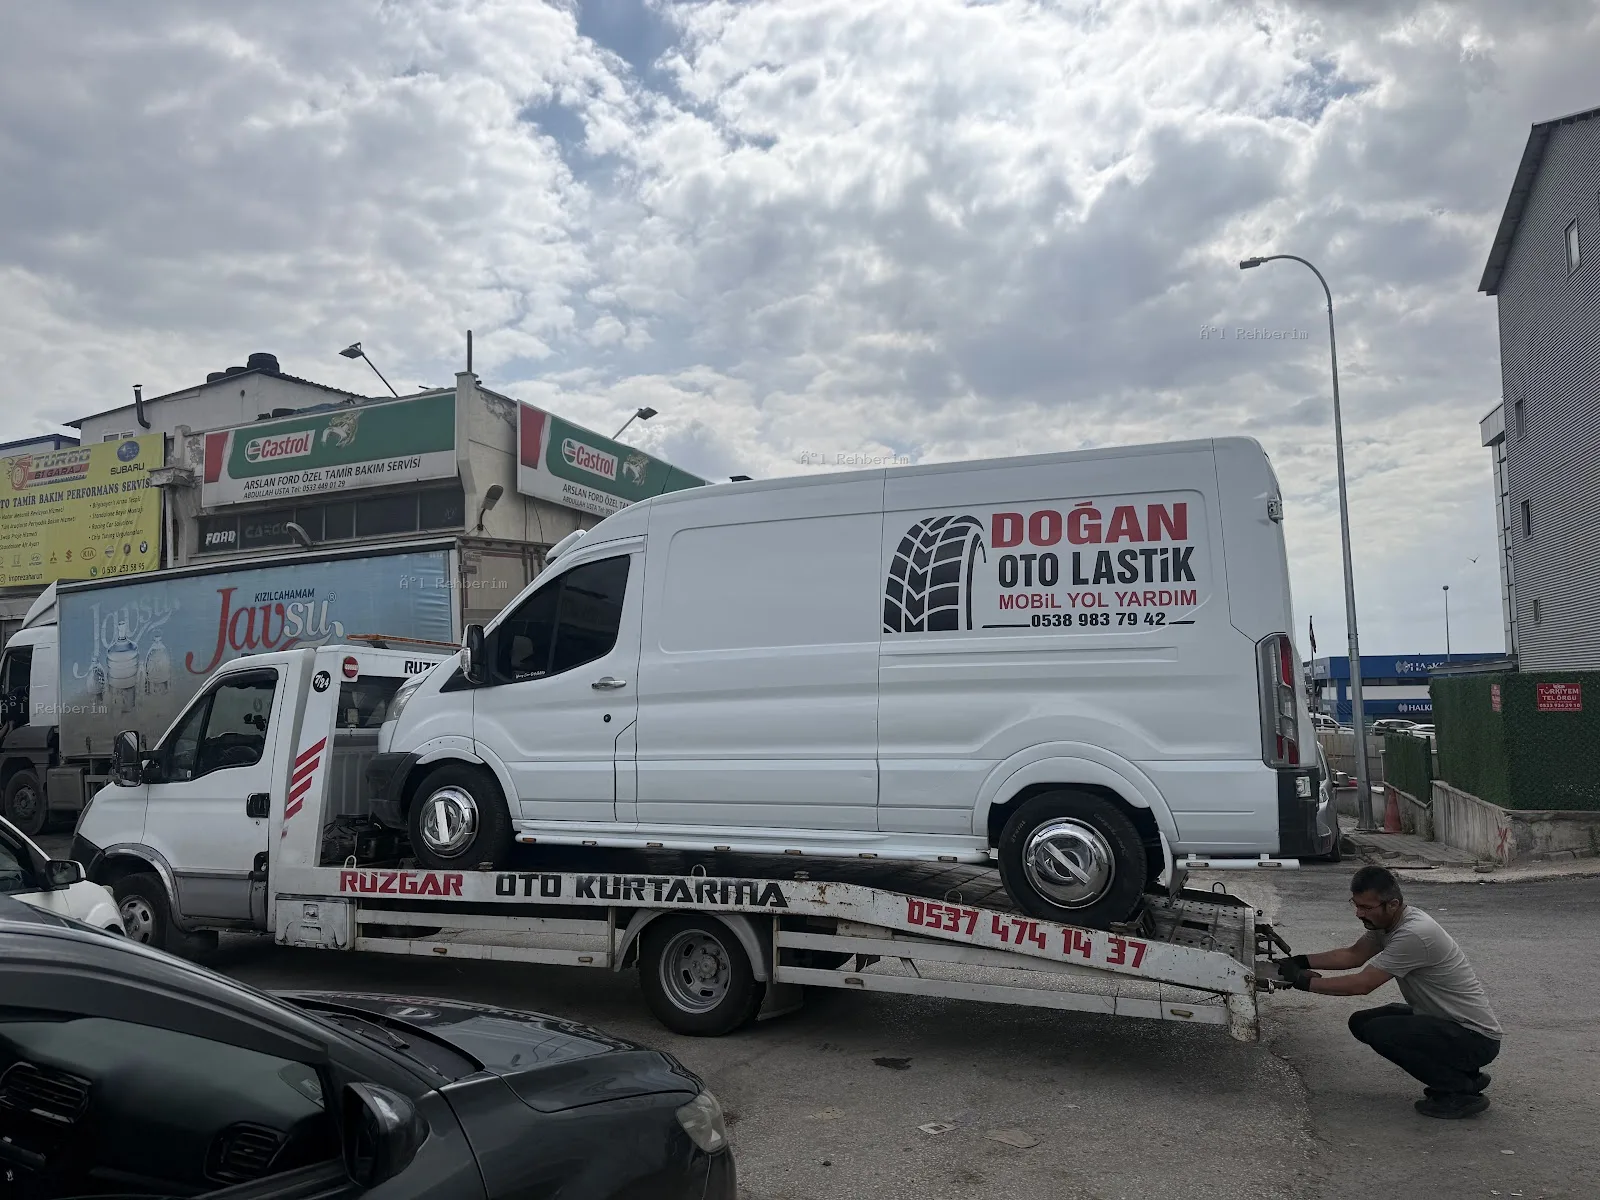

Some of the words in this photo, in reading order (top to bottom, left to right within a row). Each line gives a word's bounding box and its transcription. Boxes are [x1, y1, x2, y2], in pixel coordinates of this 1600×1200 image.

[261, 432, 310, 458] Castrol
[47, 465, 82, 478] GARAJ
[110, 462, 144, 475] SUBARU
[243, 478, 276, 490] ARSLAN
[277, 474, 300, 486] FORD
[302, 471, 322, 483] ÖZEL
[325, 466, 353, 480] TAMİR
[355, 463, 384, 476] BAKIM
[386, 456, 421, 472] SERVİSİ
[576, 445, 615, 477] Castrol
[13, 492, 36, 508] TAMİR
[39, 491, 64, 504] BAKIM
[66, 483, 119, 500] PERFORMANS
[243, 489, 274, 499] ABDULLAH
[275, 488, 290, 496] USTA
[562, 484, 588, 498] ARSLAN
[588, 492, 604, 504] FORD
[604, 495, 618, 508] ÖZEL
[991, 501, 1188, 549] DOĞAN
[206, 531, 236, 546] FORD
[998, 552, 1059, 588] OTO
[254, 588, 315, 602] KIZILCAHAMAM
[1066, 592, 1110, 608] YOL
[1114, 590, 1197, 607] YARDIM
[1031, 614, 1072, 628] 0538
[1078, 612, 1110, 627] 983
[1116, 612, 1138, 626] 79
[1143, 612, 1166, 626] 42
[340, 871, 463, 896] RÜZGAR
[496, 874, 562, 897] OTO
[576, 876, 788, 908] KURTARMA
[906, 898, 981, 936] 0537
[992, 916, 1046, 950] 474
[1062, 929, 1092, 958] 14
[1106, 938, 1147, 969] 37
